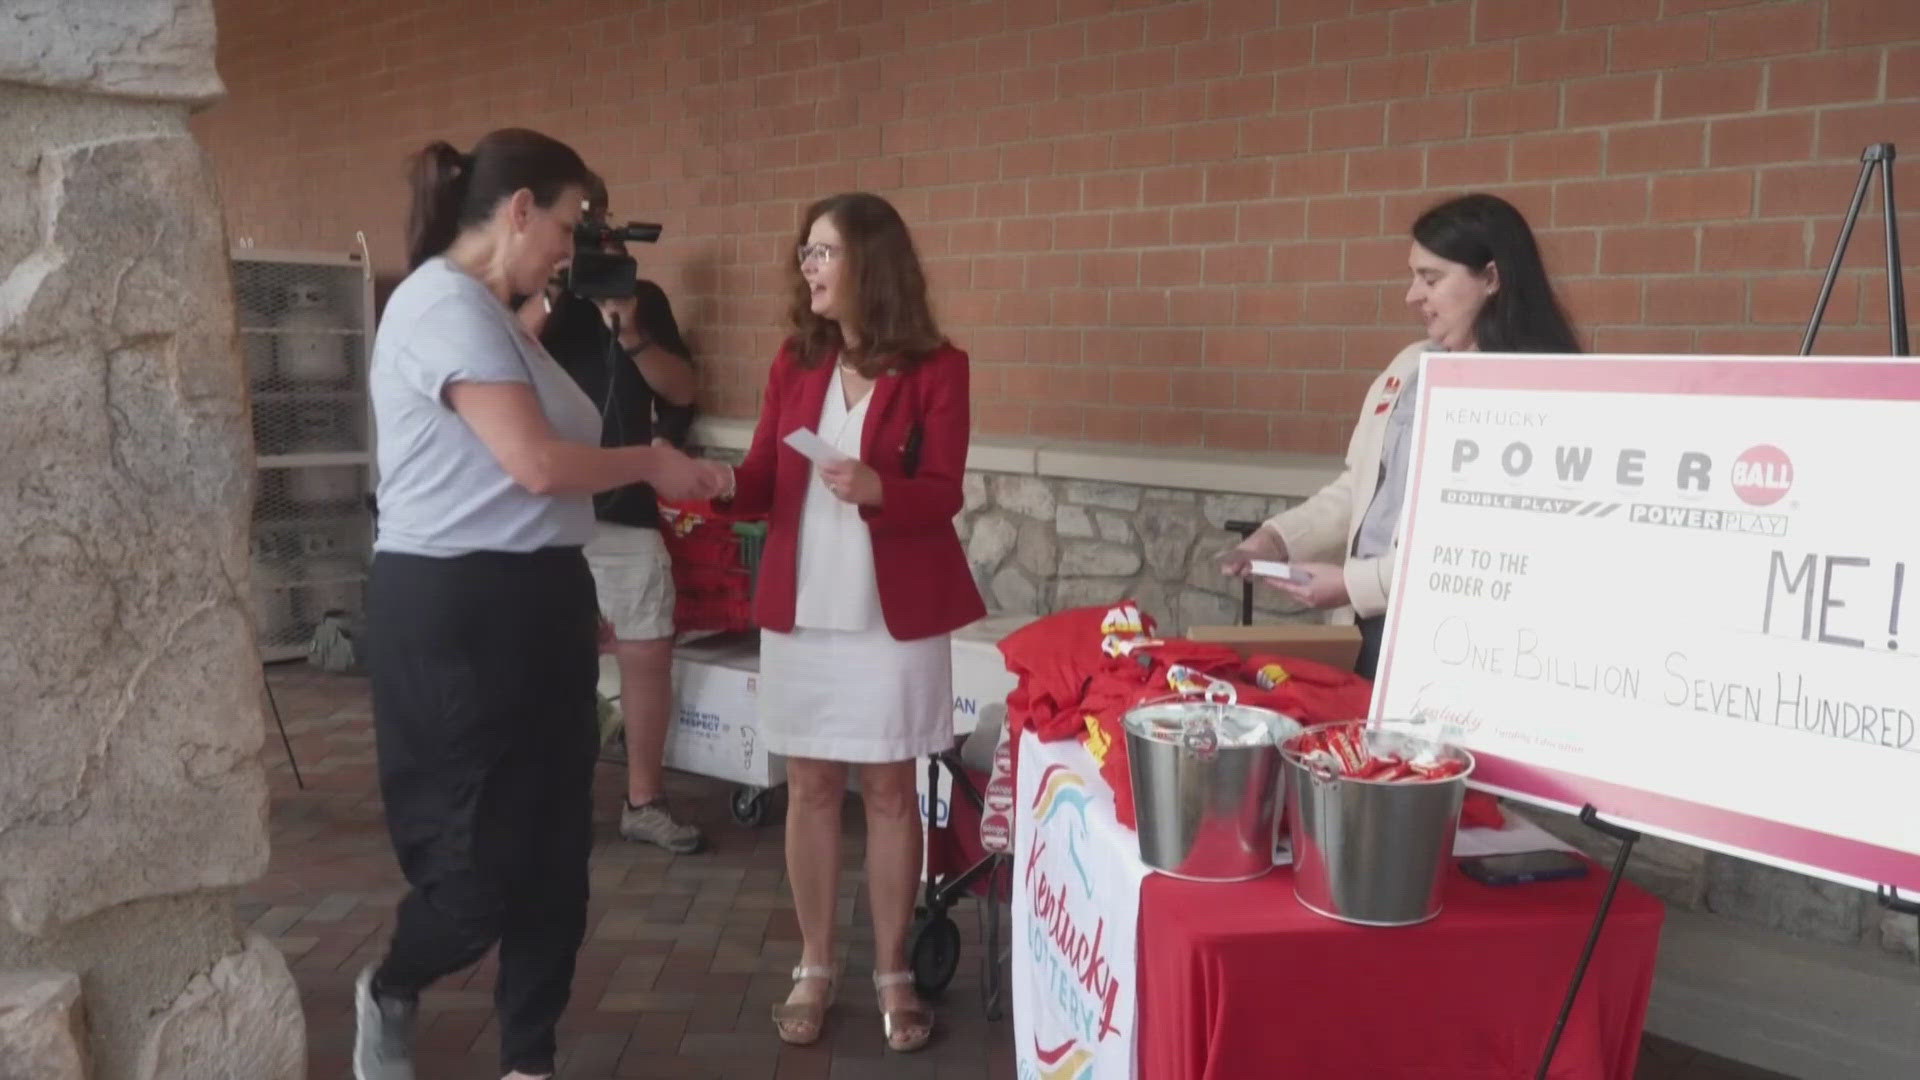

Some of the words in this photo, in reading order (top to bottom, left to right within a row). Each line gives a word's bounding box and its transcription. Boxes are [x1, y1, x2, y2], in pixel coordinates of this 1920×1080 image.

[1446, 408, 1548, 426] KENTUCKY
[1447, 492, 1514, 508] DOUBLE
[1521, 497, 1563, 512] PLAY
[1432, 544, 1464, 566] PAY
[1471, 548, 1491, 570] TO
[1499, 551, 1529, 575] THE
[1429, 571, 1484, 597] ORDER
[1491, 580, 1512, 601] OF
[1762, 549, 1905, 650] ME!
[953, 696, 976, 715] AN
[680, 716, 720, 732] RESPECT
[701, 712, 720, 722] WITH
[1535, 737, 1585, 753] Education
[1025, 827, 1121, 1043] Kentucky
[1027, 913, 1095, 1043] LOTTERY
